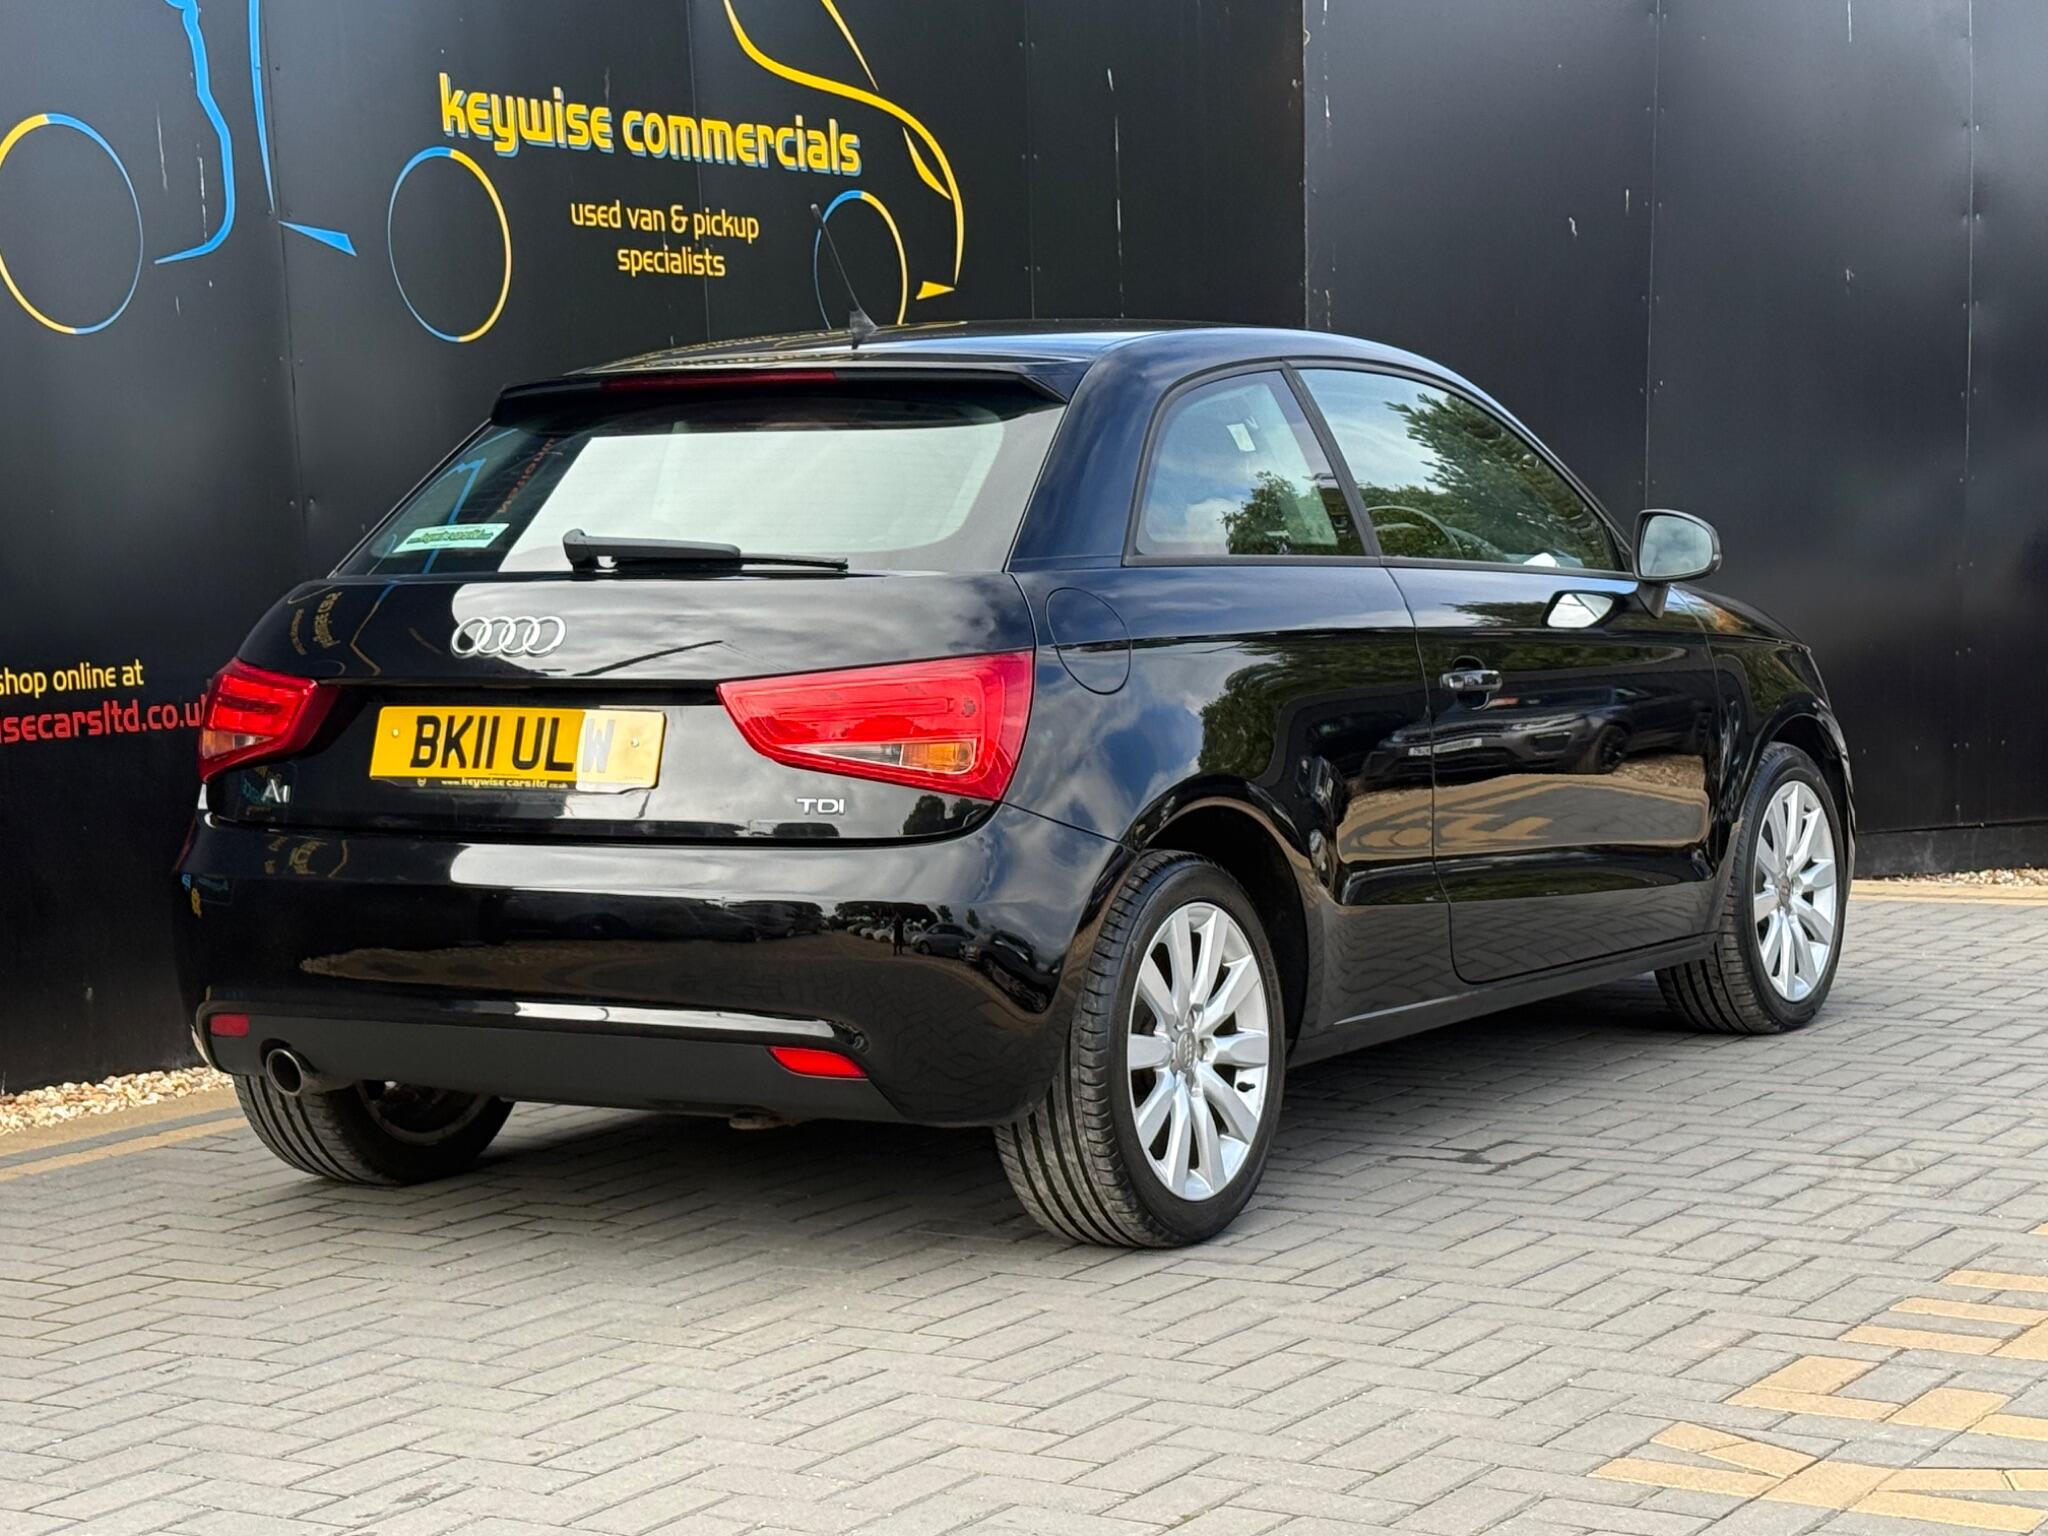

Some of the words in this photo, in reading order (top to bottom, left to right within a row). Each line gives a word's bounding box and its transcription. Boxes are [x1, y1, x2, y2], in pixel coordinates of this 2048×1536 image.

[439, 72, 615, 157] keywise
[622, 111, 863, 177] commercials
[570, 199, 622, 229] used
[627, 206, 666, 232] van
[671, 205, 689, 234] &
[693, 207, 760, 244] pickup
[617, 245, 726, 277] specialists
[53, 662, 117, 692] online
[122, 658, 144, 686] at
[0, 694, 206, 743] secarsltd.co.u
[409, 715, 501, 769] BK11
[261, 778, 291, 803] A1
[796, 798, 845, 815] TDI
